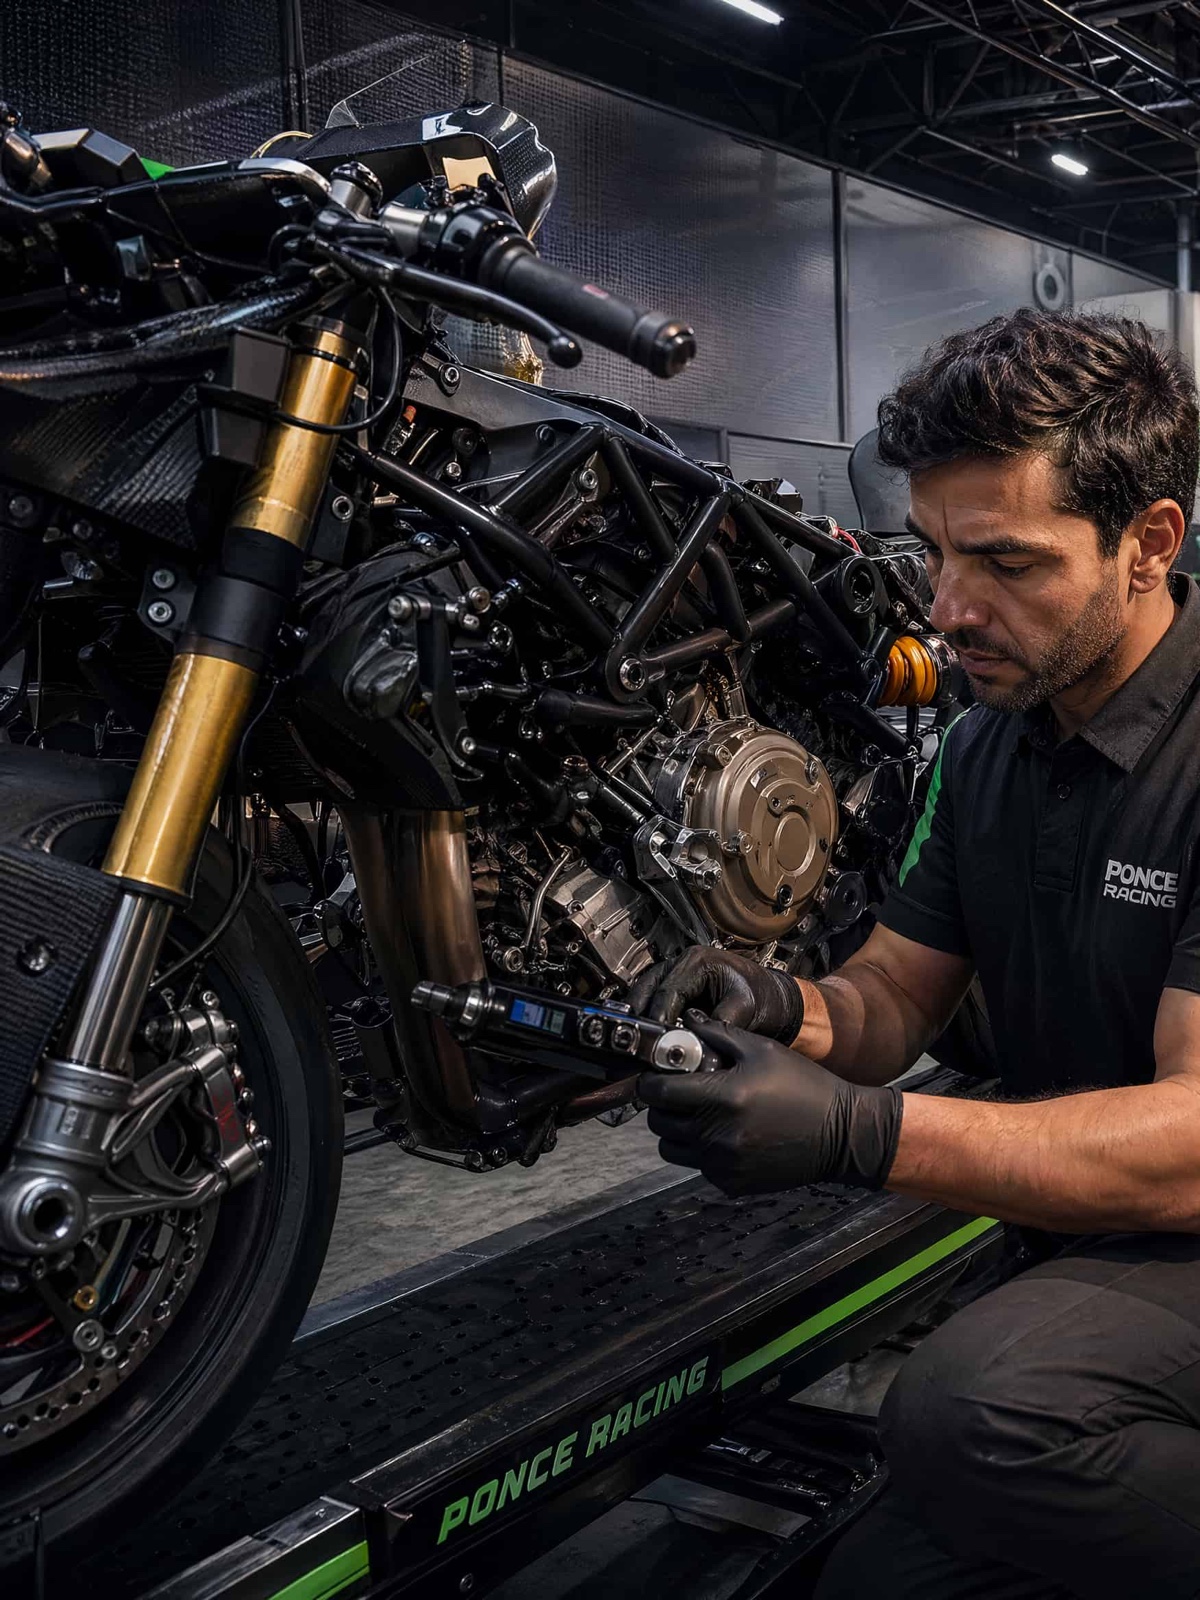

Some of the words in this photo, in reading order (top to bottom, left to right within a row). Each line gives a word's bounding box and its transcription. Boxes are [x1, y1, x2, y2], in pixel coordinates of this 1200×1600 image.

[1104, 859, 1179, 893] PONCE
[1103, 883, 1177, 908] RACING
[437, 1431, 579, 1545] PONCE
[585, 1356, 709, 1458] RACING
